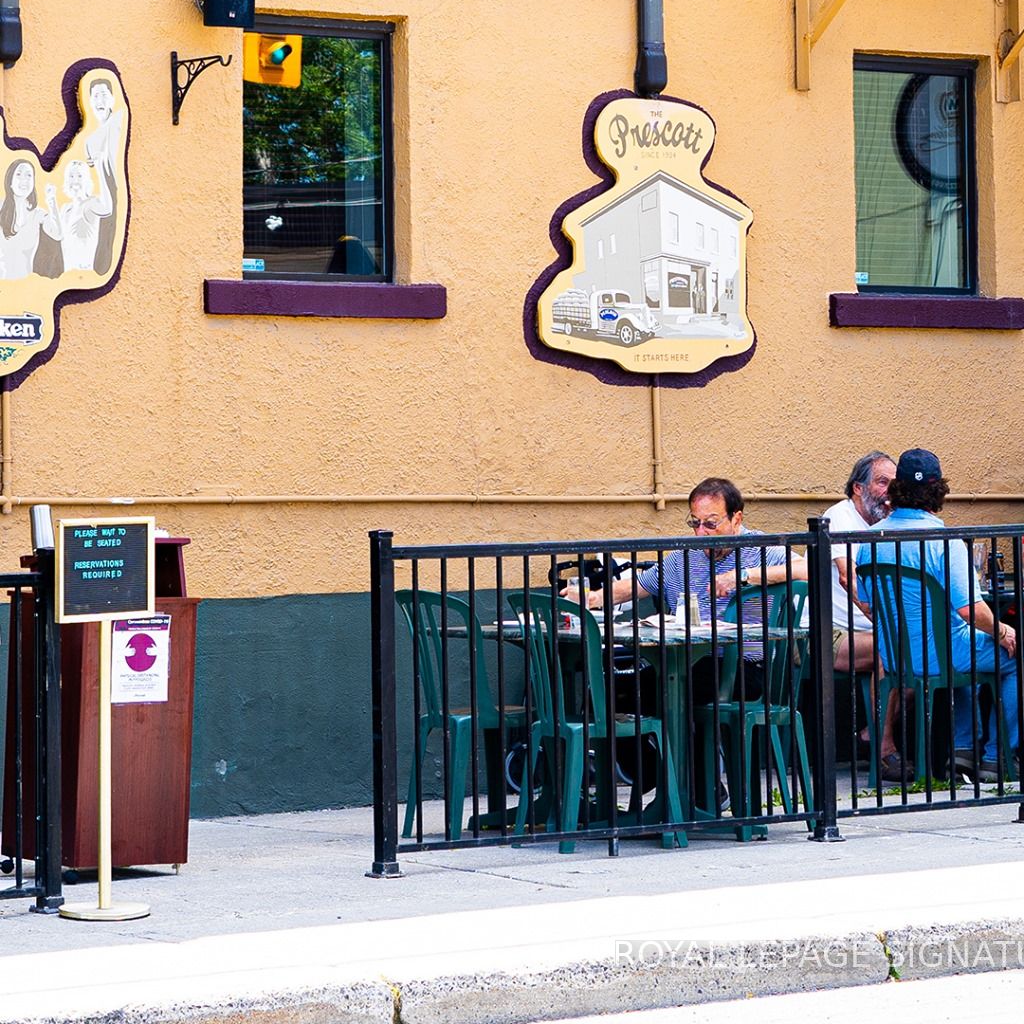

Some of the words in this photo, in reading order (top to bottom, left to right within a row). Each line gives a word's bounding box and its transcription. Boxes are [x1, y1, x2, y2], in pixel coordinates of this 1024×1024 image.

[649, 110, 663, 118] THE
[608, 113, 704, 158] Prescott
[633, 354, 640, 362] IT
[642, 353, 670, 362] STARTS
[670, 353, 689, 362] HERE
[74, 529, 98, 538] PLEASE
[101, 528, 115, 537] WAIT
[117, 528, 127, 536] TO
[83, 539, 93, 548] BE
[97, 538, 122, 547] SEATED
[74, 559, 124, 570] RESERVATIONS
[82, 570, 123, 580] REQUIRED
